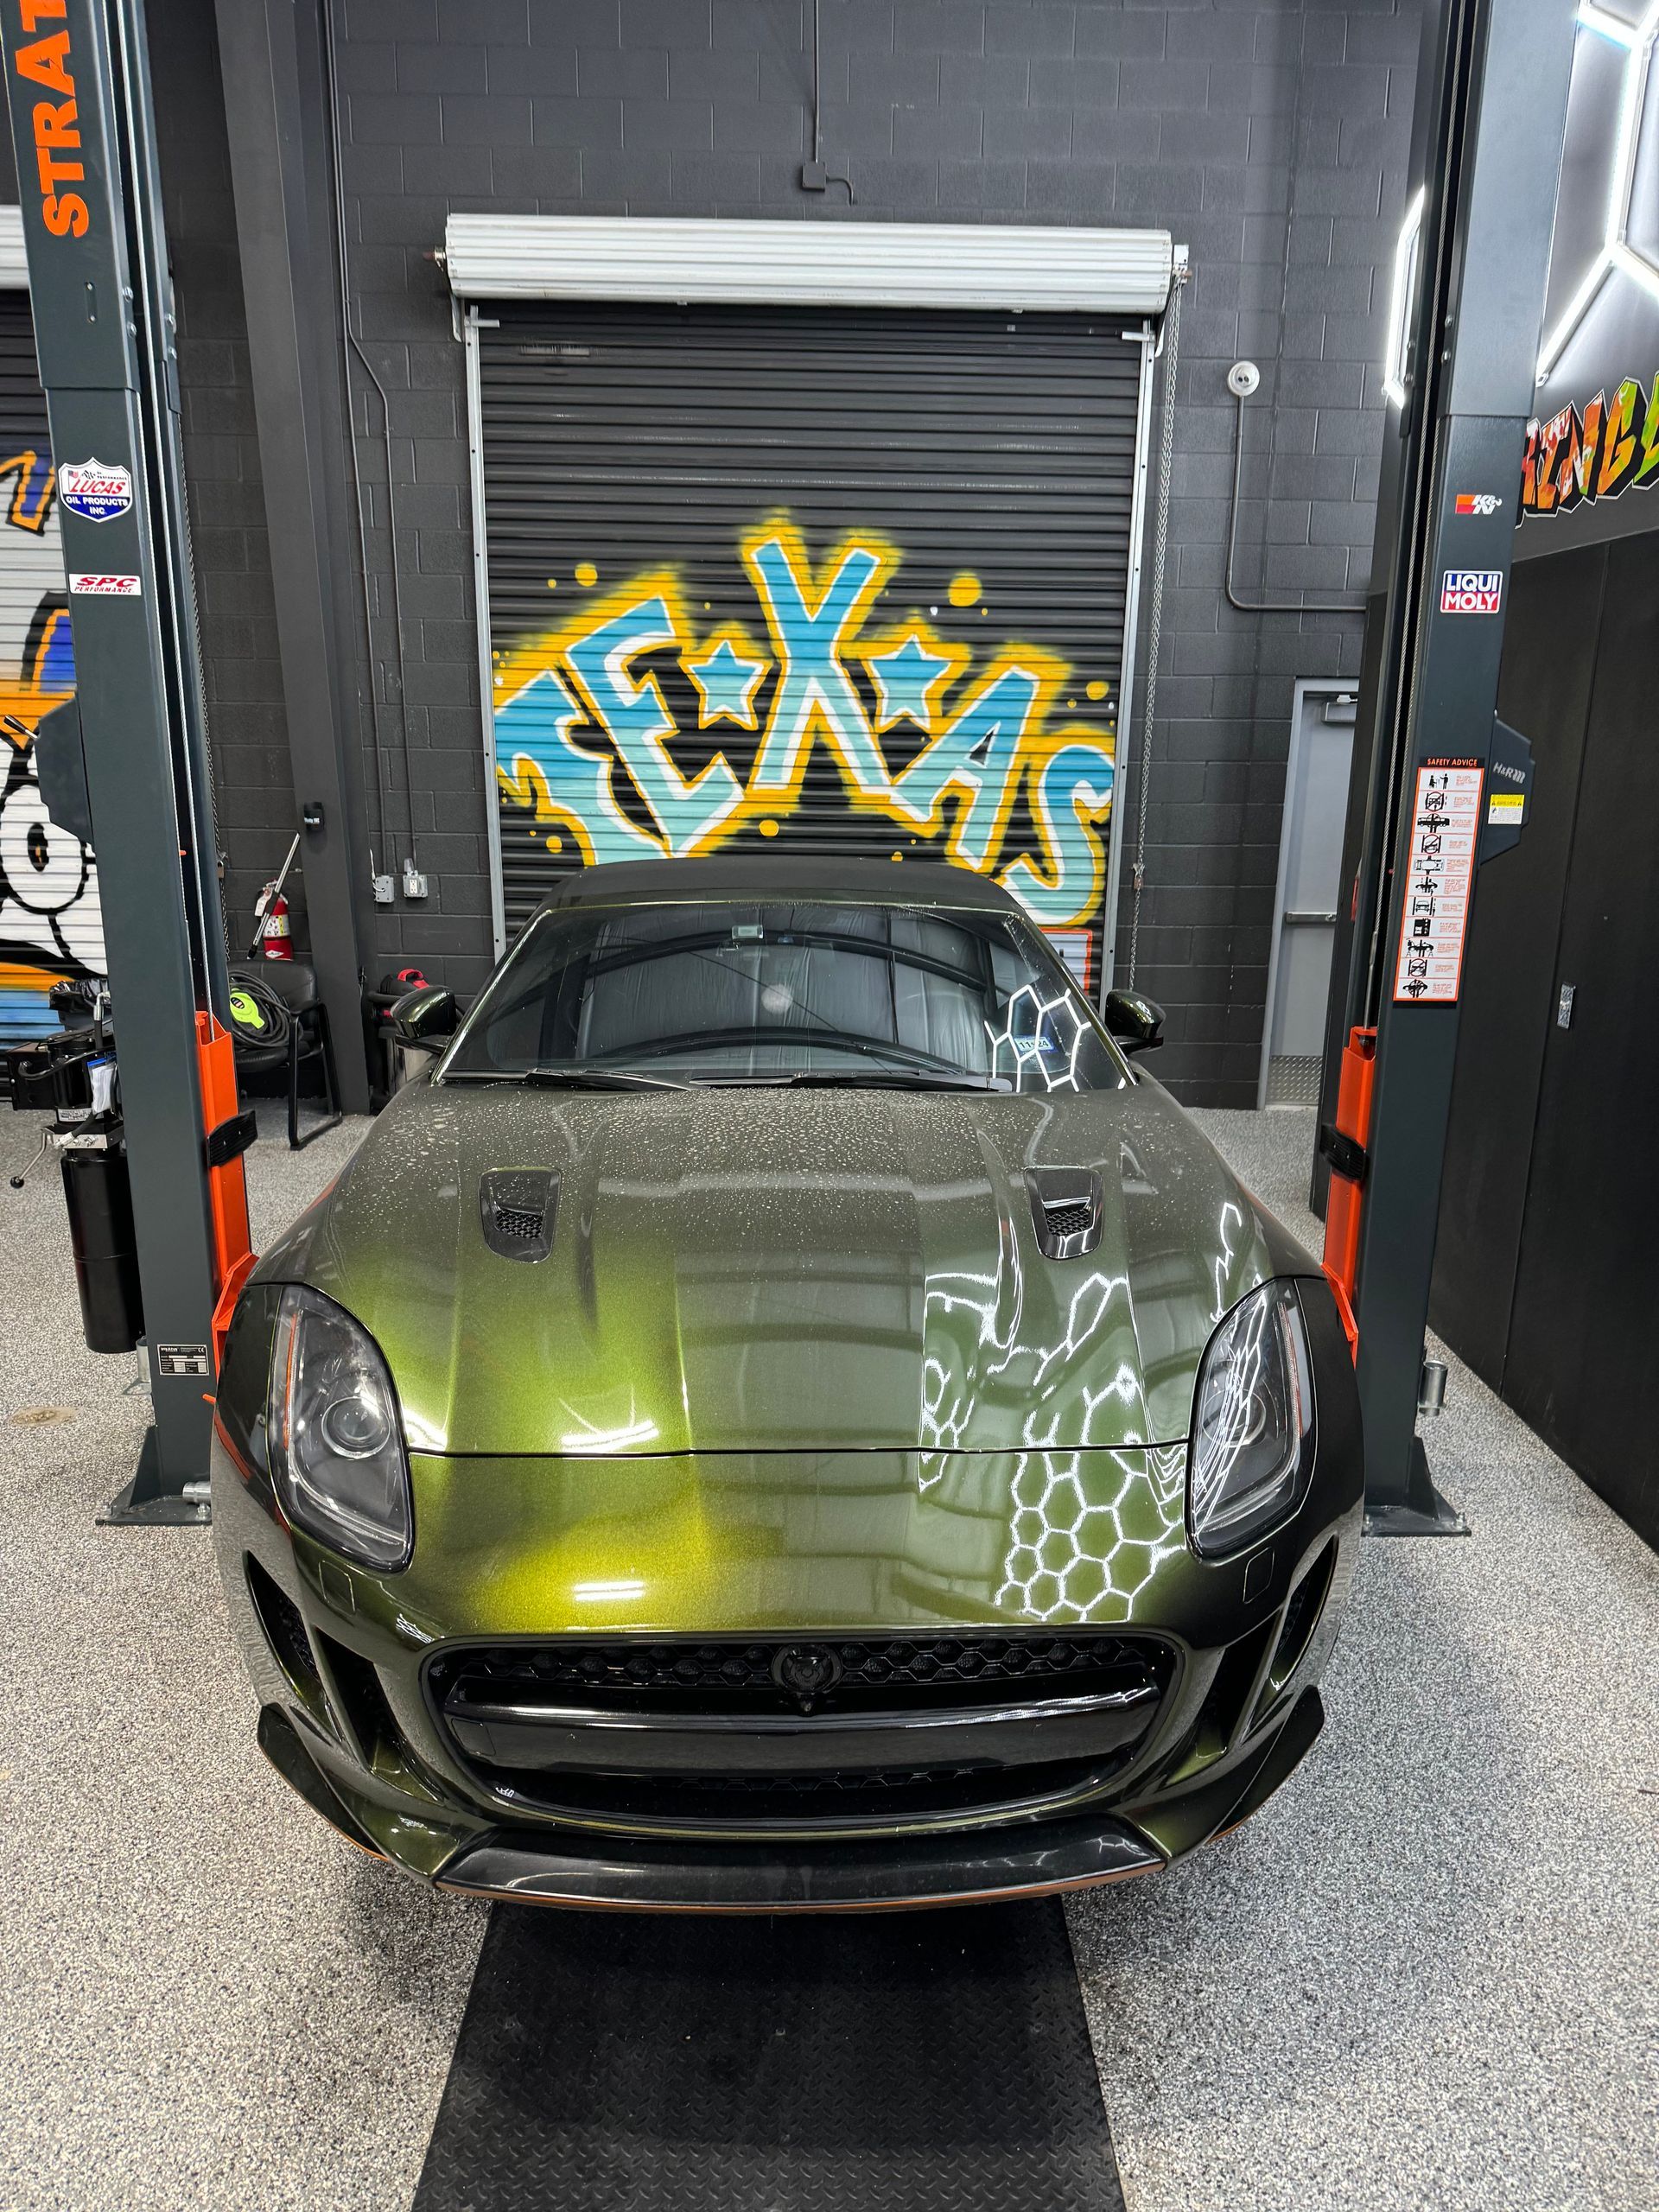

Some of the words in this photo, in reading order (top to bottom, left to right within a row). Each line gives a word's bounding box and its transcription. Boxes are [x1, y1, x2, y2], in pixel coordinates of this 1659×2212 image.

[70, 479, 125, 494] LUCAS
[66, 495, 81, 505] OIL
[82, 496, 129, 507] PRODUCTS
[77, 577, 137, 588] SPC
[1446, 574, 1498, 593] LIQUI
[1445, 592, 1498, 610] MOLY
[494, 531, 1116, 926] TEXAS
[1427, 758, 1450, 766] SAFETY
